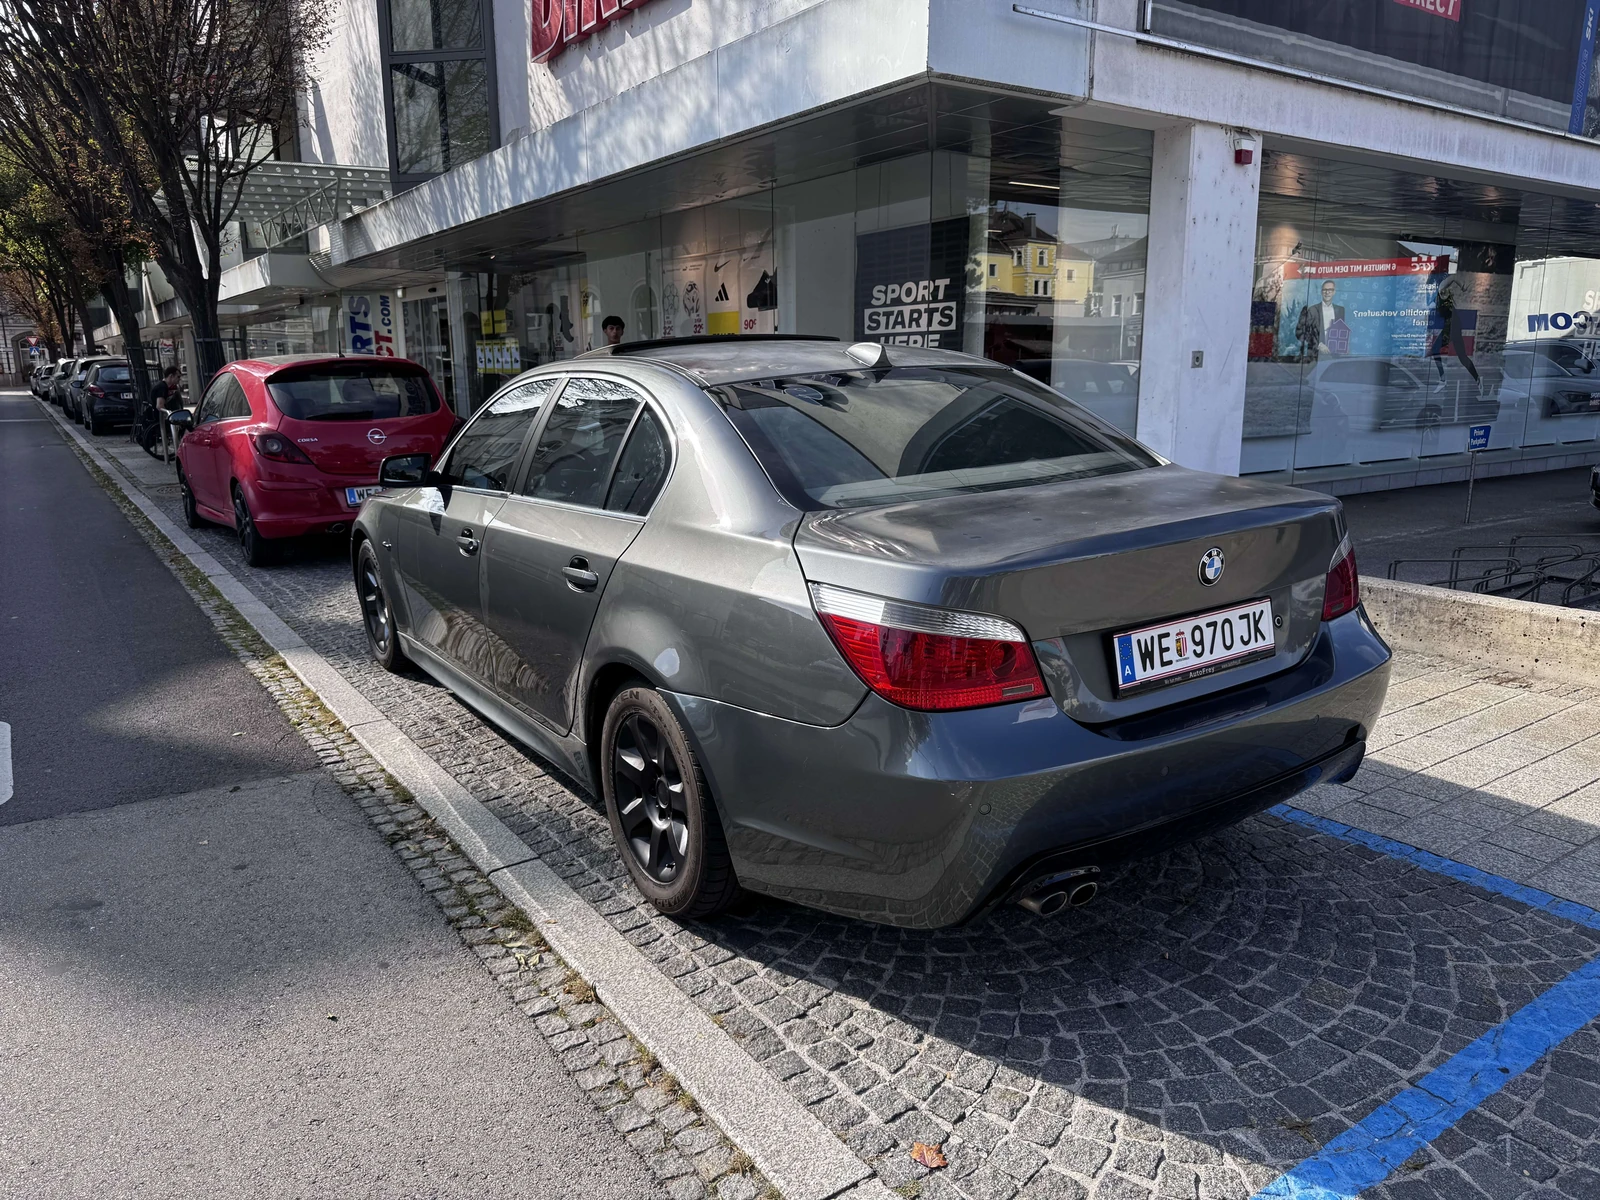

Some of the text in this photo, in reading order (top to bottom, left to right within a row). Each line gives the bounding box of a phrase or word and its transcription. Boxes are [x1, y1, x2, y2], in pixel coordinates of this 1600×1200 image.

[1585, 7, 1595, 41] SKI
[870, 278, 951, 306] SPORT
[866, 305, 954, 331] STARTS
[1136, 609, 1266, 673] WE 970 JK
[1124, 664, 1132, 677] A
[1188, 666, 1215, 679] AutoFrey
